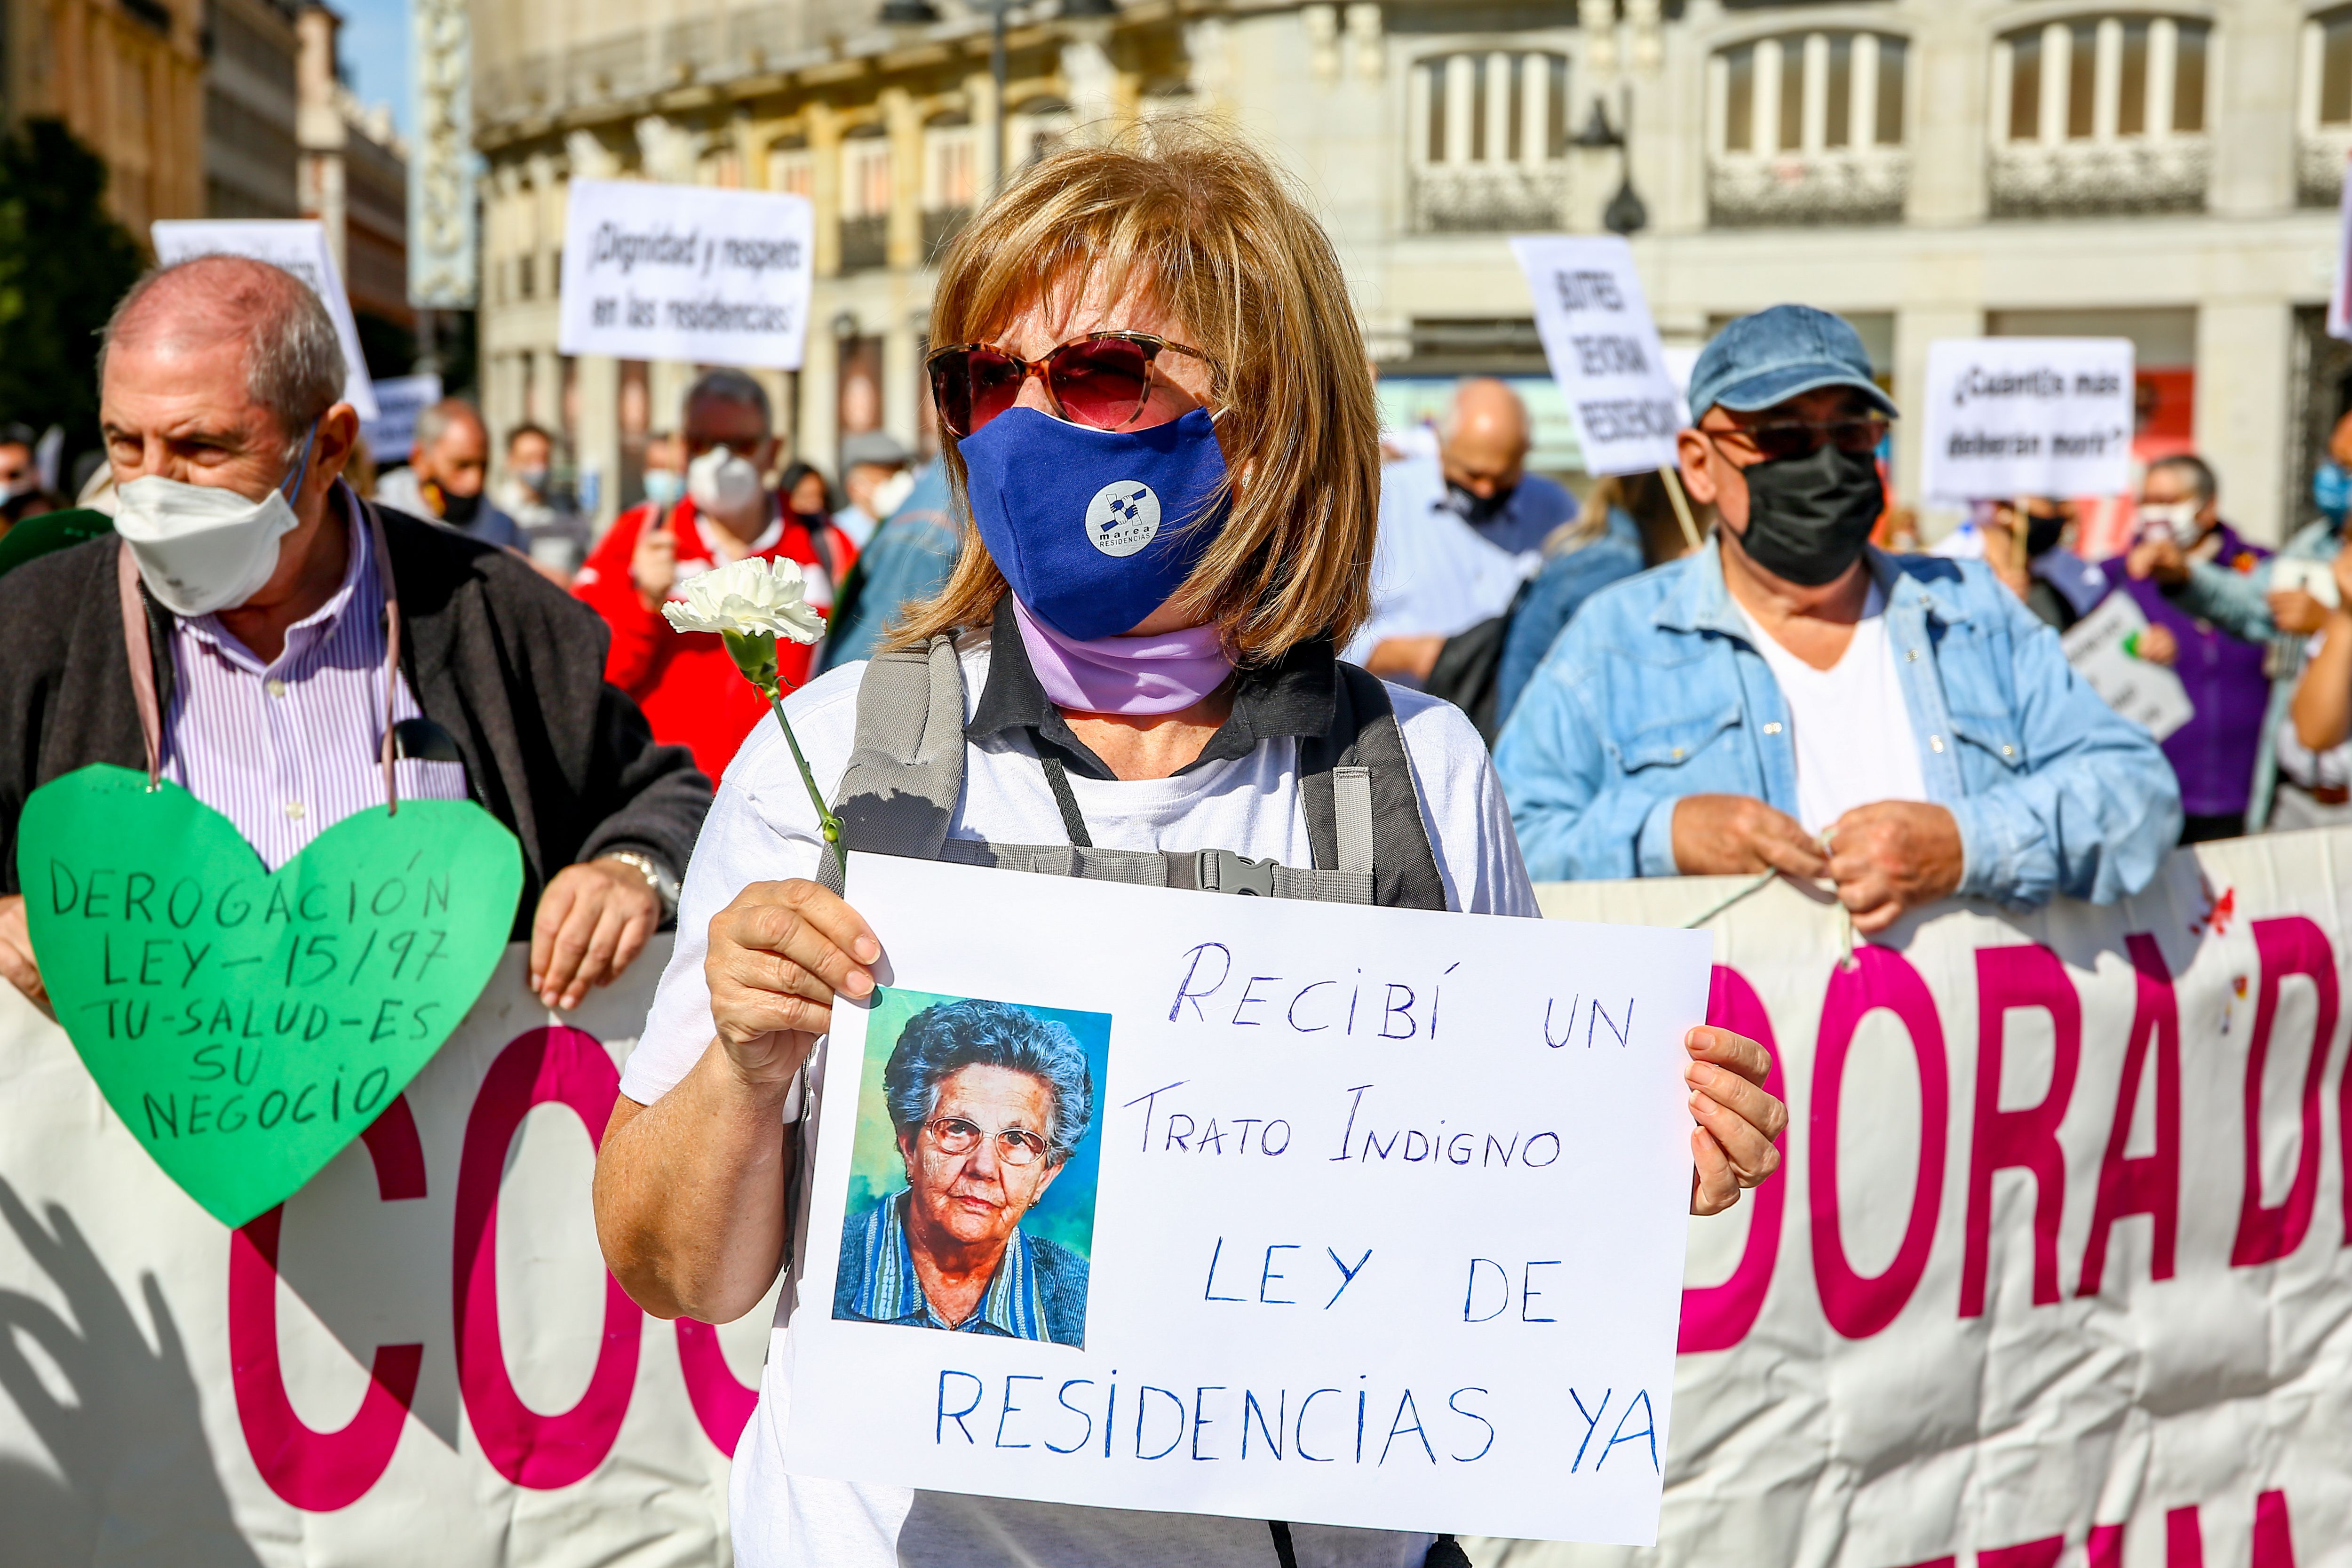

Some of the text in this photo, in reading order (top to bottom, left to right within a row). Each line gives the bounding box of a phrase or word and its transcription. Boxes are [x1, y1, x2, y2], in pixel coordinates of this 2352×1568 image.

[1100, 525, 1150, 540] marea
[1100, 533, 1150, 548] RESIDENCIAS
[50, 849, 450, 929] DEROGACIÓN
[1543, 993, 1635, 1049] UN
[190, 1044, 262, 1087] SU
[143, 1064, 390, 1140] NEGOCIO
[1204, 1235, 1562, 1323] LEY DE
[1568, 1387, 1661, 1476] YA
